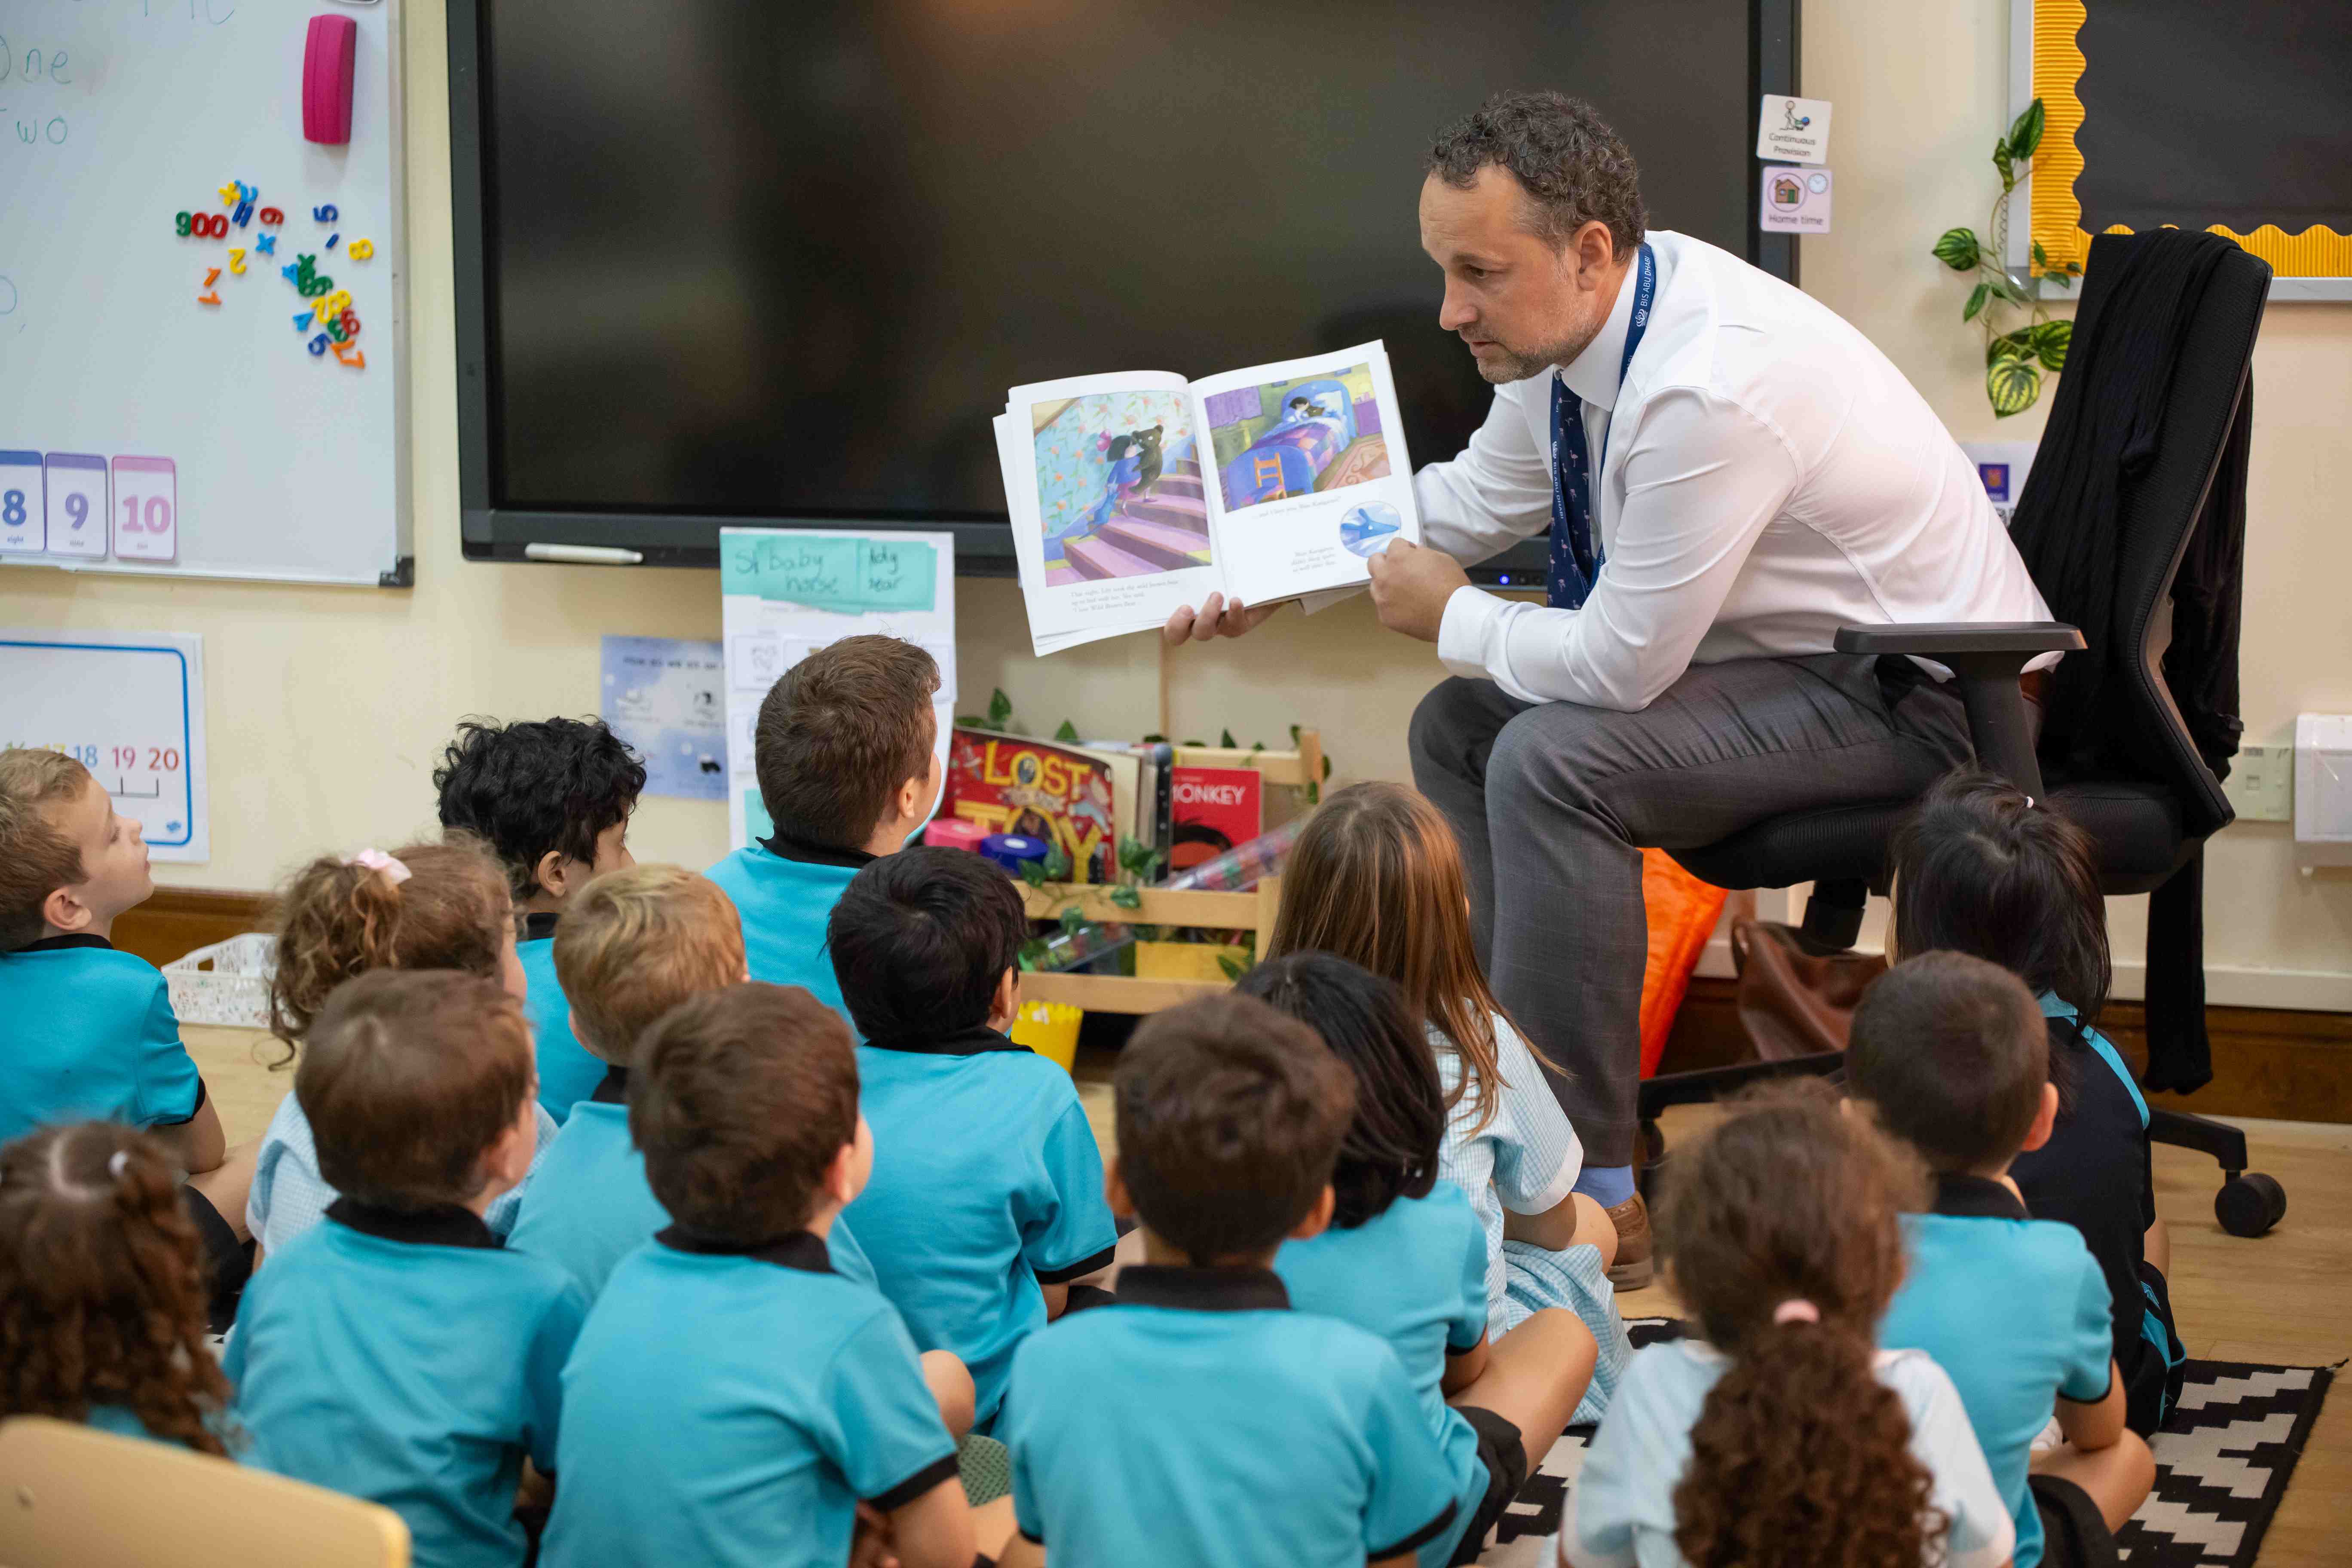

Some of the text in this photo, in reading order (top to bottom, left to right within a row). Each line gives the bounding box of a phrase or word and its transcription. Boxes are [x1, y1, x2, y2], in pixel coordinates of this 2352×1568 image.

[1769, 132, 1816, 145] Continuous
[1769, 215, 1823, 225] Home time
[1640, 293, 1649, 306] BIS
[2, 489, 27, 526] 8
[65, 493, 89, 530] 9
[122, 494, 172, 534] 10
[74, 744, 98, 768] 18
[111, 746, 136, 770] 19
[148, 747, 180, 771] 20
[983, 740, 1092, 801] LOST
